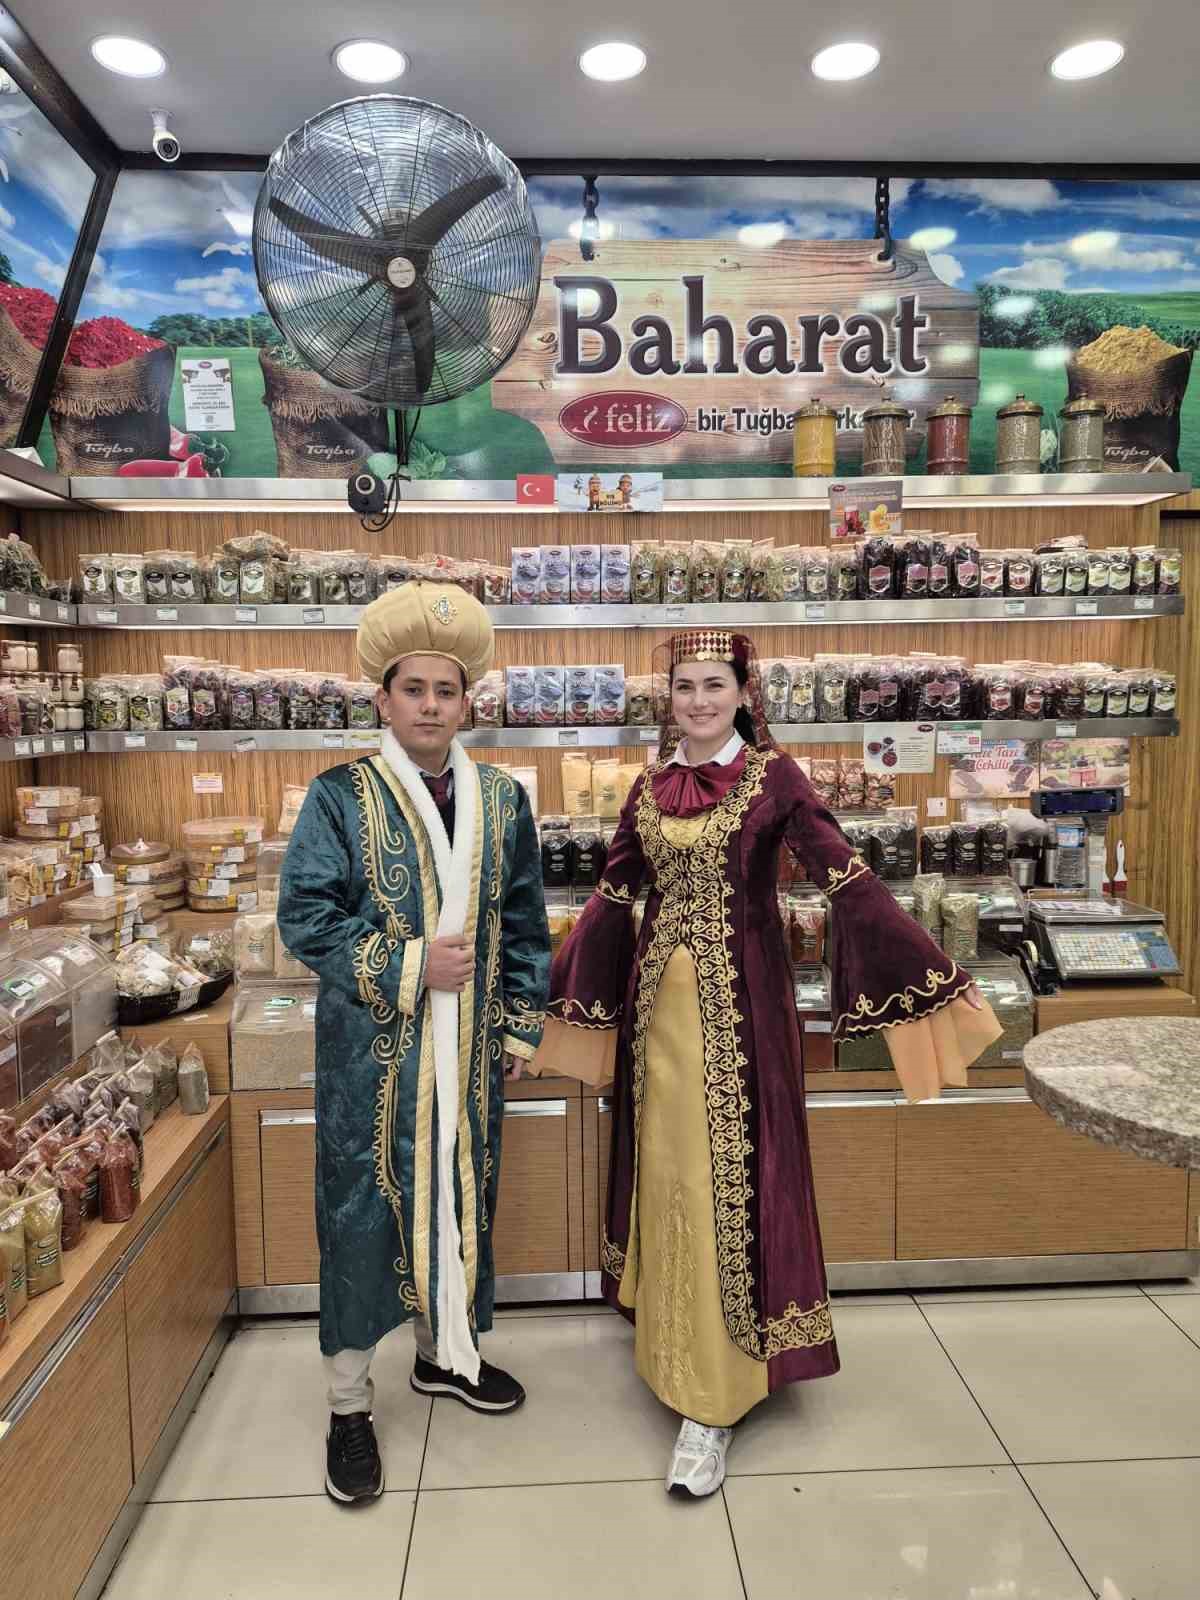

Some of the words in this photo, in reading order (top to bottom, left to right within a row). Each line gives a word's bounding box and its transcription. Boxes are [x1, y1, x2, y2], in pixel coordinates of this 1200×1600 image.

[554, 275, 927, 375] Baharat
[697, 407, 726, 431] bir
[732, 407, 796, 436] Tuğba
